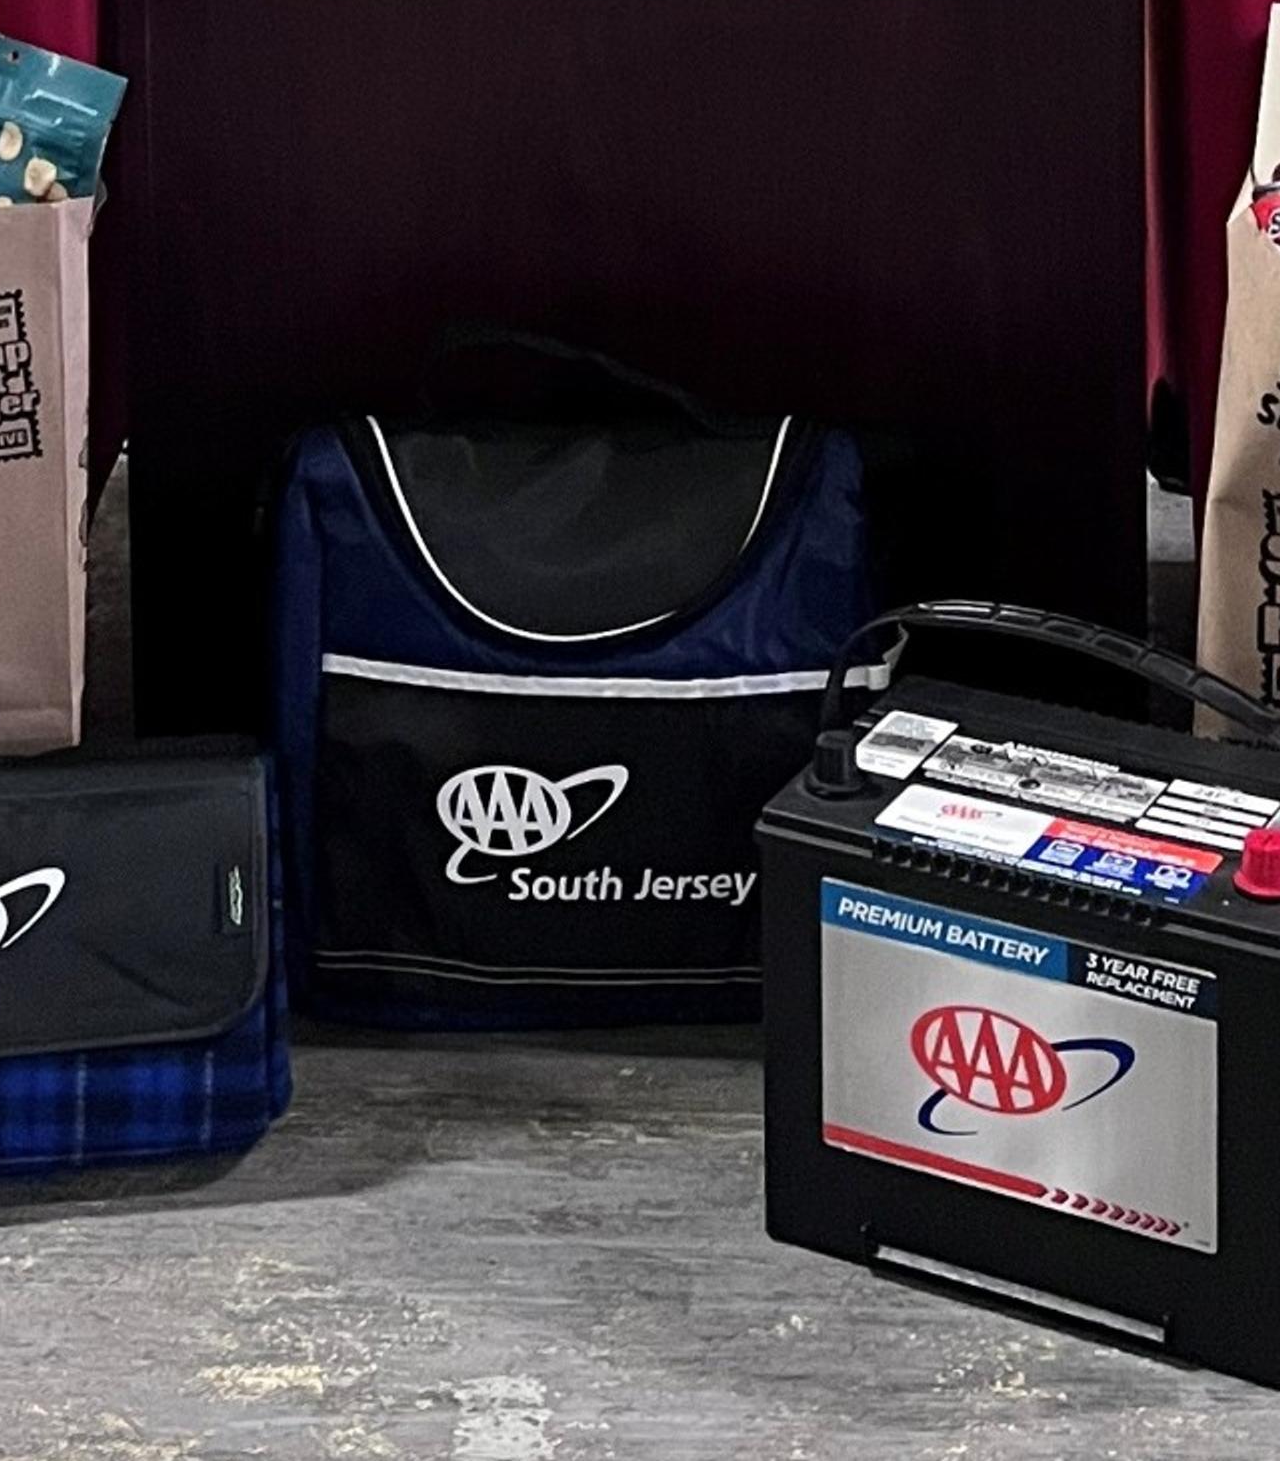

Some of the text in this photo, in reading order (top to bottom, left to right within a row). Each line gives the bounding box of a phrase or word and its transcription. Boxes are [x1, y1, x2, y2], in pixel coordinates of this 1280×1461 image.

[508, 865, 755, 906] South Jersey
[837, 898, 1050, 967] PREMIUM BATTERY
[1086, 953, 1201, 994] 3 YEAR FREE
[1086, 971, 1196, 1009] REPLACEMENT
[922, 1007, 1057, 1115] AAA
